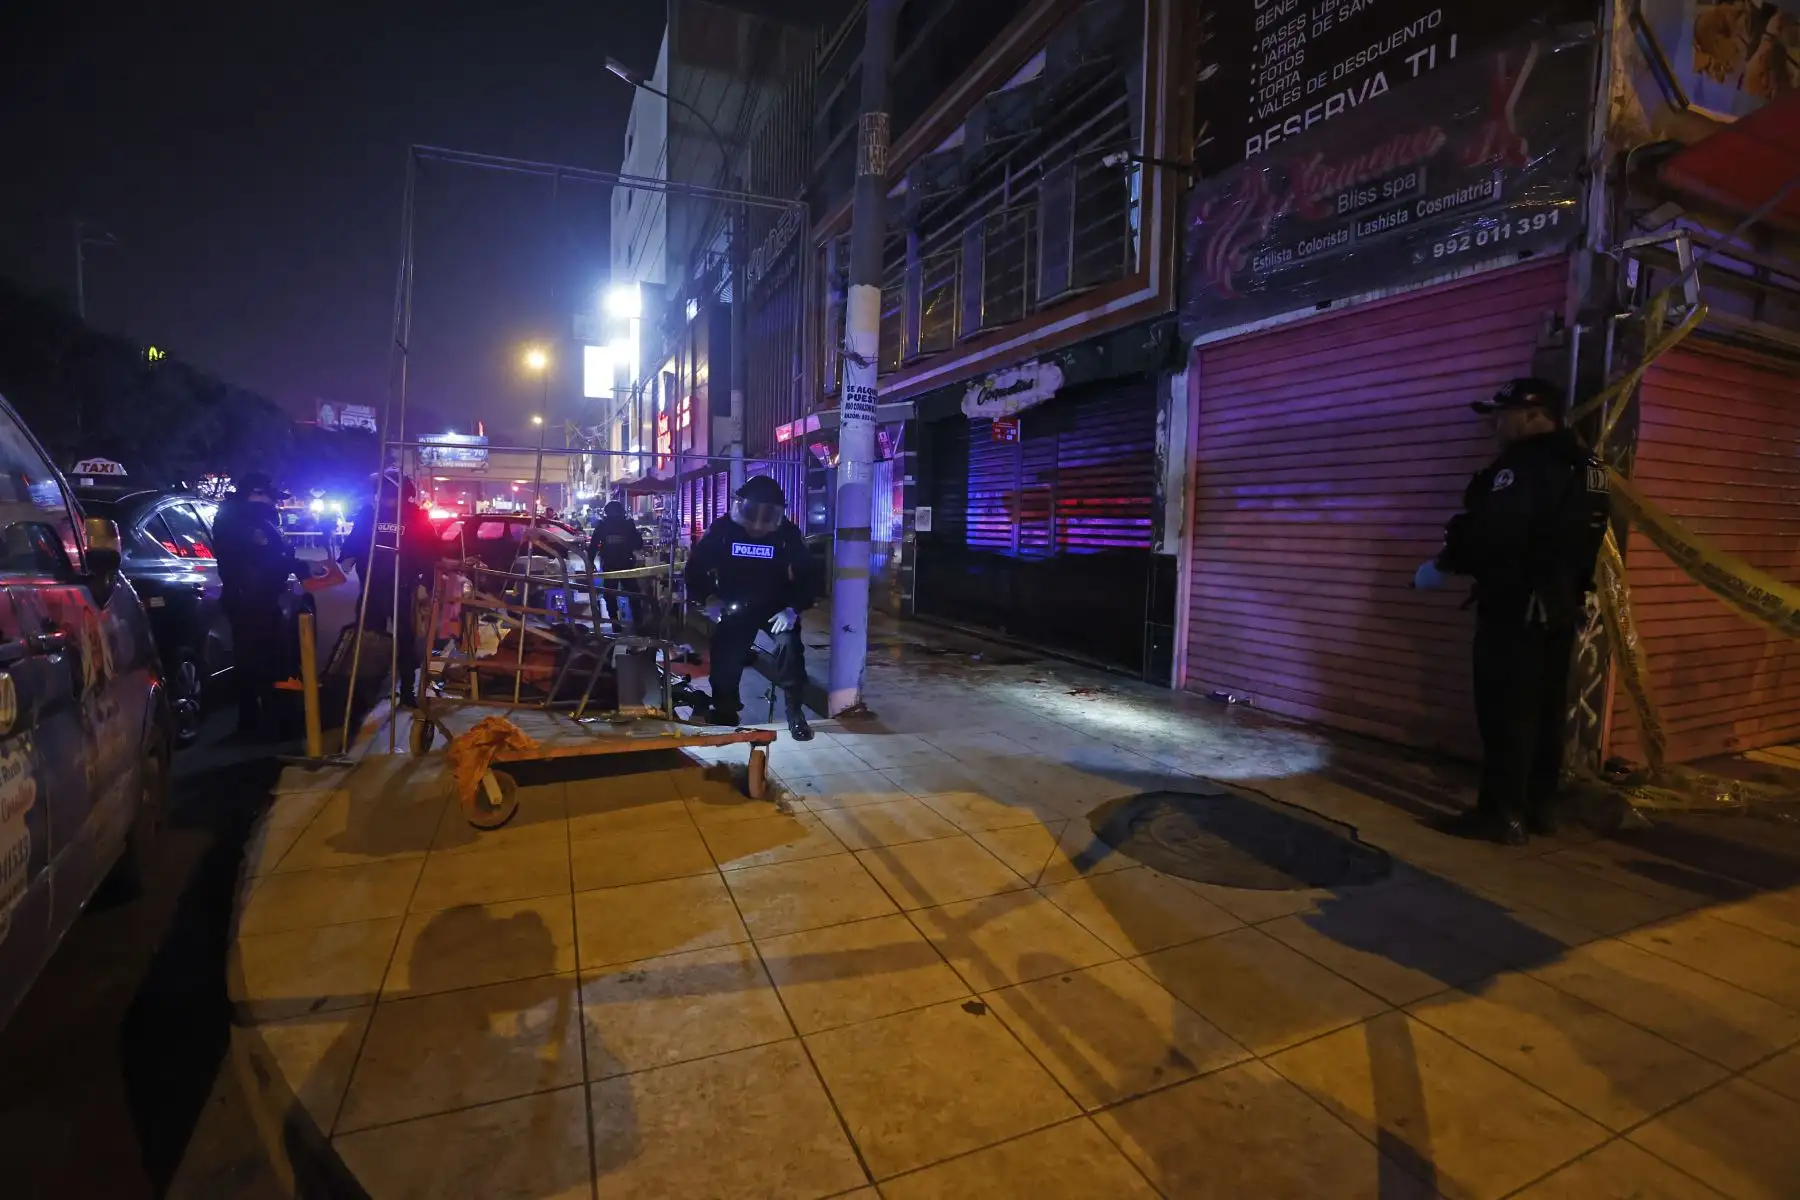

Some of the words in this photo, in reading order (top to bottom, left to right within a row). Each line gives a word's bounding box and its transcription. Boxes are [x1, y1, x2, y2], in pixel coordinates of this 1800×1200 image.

[1260, 32, 1306, 69] JARRA
[1312, 15, 1333, 38] DE
[1262, 13, 1306, 52] PASES
[1258, 87, 1301, 119] VALES
[1307, 71, 1327, 95] DE
[1333, 8, 1442, 80] DESCUENTO
[1260, 49, 1304, 86] FOTOS
[1258, 70, 1300, 102] TORTA
[1337, 184, 1377, 213] Bliss
[1383, 172, 1417, 199] spa
[1252, 248, 1292, 272] Estilista
[1298, 228, 1348, 256] Colorista
[1357, 208, 1408, 237] Lashista
[1416, 178, 1493, 217] Cosmiatria
[1432, 235, 1470, 258] 992
[1476, 223, 1511, 247] 011
[1516, 209, 1559, 235] 391
[847, 385, 855, 393] SE
[81, 463, 115, 473] TAXI
[734, 545, 771, 557] POLICIA
